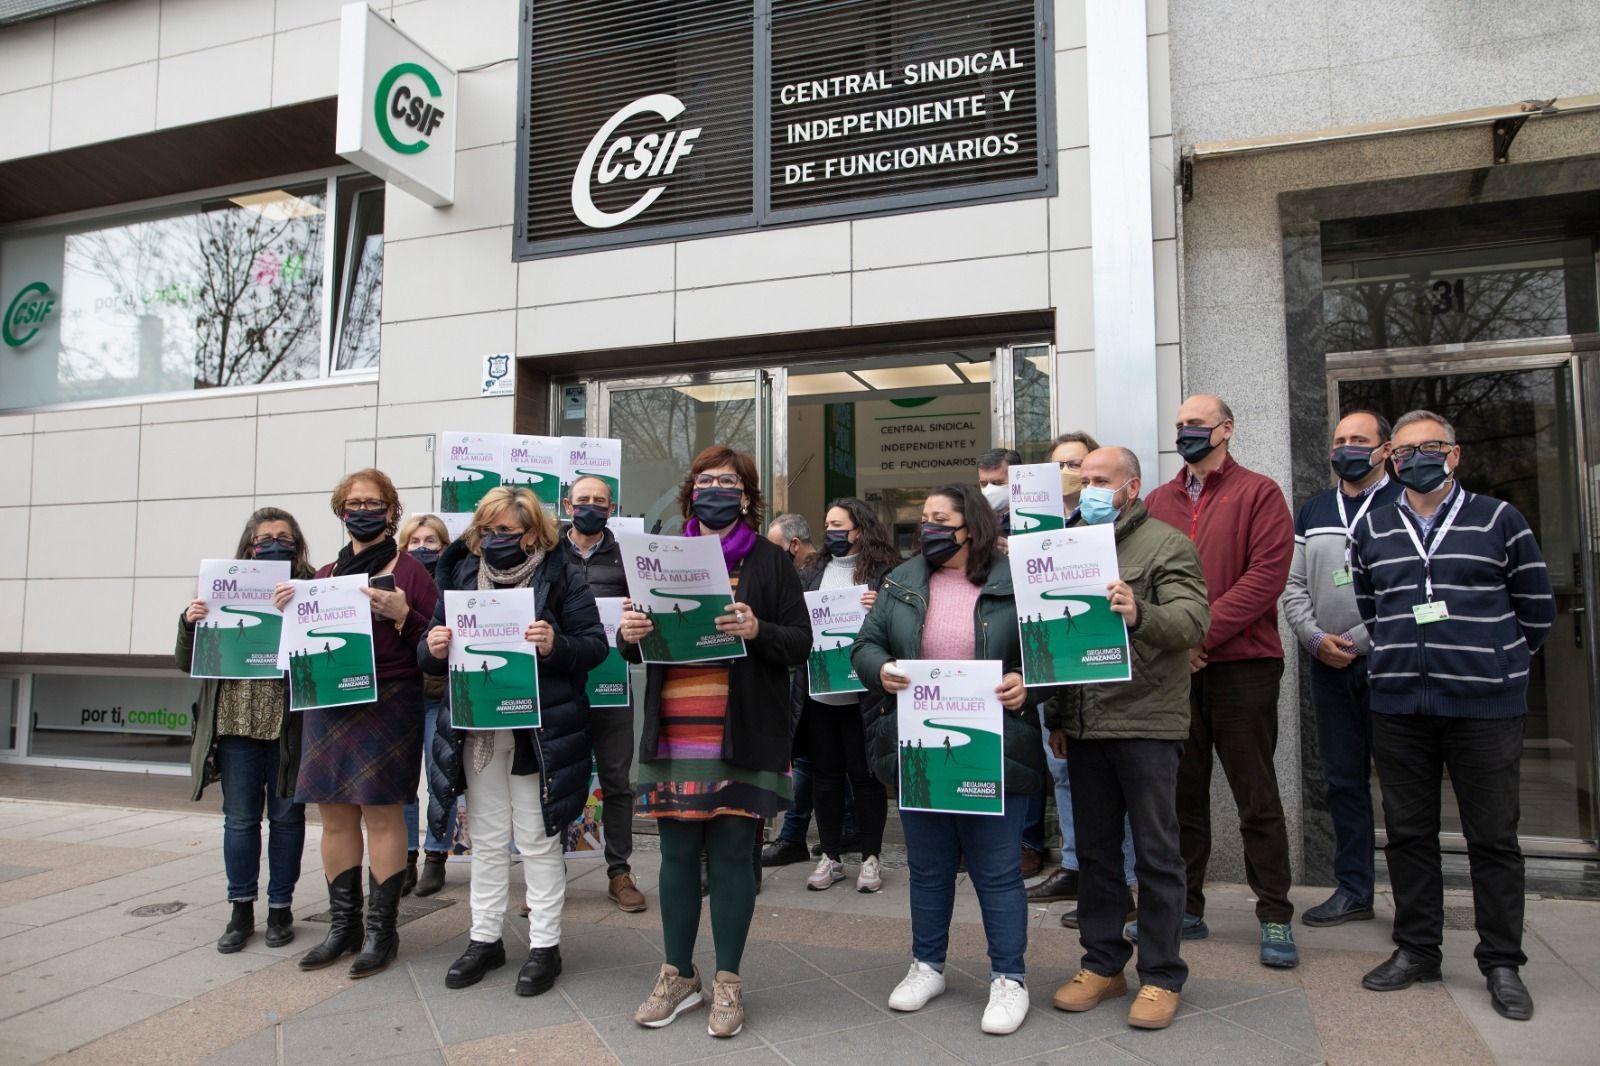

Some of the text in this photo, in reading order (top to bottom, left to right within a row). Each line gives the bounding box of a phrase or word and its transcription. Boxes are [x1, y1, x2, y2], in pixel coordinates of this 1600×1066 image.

[780, 47, 1024, 106] CENTRAL SINDICAL
[786, 89, 1016, 144] INDEPENDIENTE Y
[784, 132, 1020, 185] DE FUNCIONARIOS
[1432, 279, 1465, 315] 31
[880, 421, 976, 435] CENTRAL SINDICAL
[451, 446, 468, 455] 8M
[881, 439, 976, 452] INDEPENDIENTE Y
[511, 448, 528, 458] 8M
[569, 450, 586, 460] 8M
[881, 457, 977, 470] DE FUNCIONARIOS
[636, 556, 662, 573] 8M
[1026, 557, 1054, 575] 8M
[638, 570, 652, 580] DE
[653, 572, 667, 581] LA
[669, 572, 711, 583] MUJER
[1028, 567, 1101, 584] DE LA MUJER
[212, 579, 237, 592] 8M
[212, 592, 226, 600] DE
[228, 592, 240, 600] LA
[297, 601, 319, 616] 8M
[812, 607, 830, 619] 8M
[298, 615, 310, 625] DE
[311, 614, 323, 622] LA
[324, 609, 356, 622] MUJER
[457, 614, 477, 629] 8M
[834, 615, 861, 624] MUJER
[482, 627, 520, 637] MUJER
[1081, 654, 1122, 663] AVANZANDO
[1086, 648, 1121, 656] SEGUIMOS
[913, 685, 940, 701] 8M
[496, 704, 533, 712] AVANZANDO
[913, 701, 986, 712] DE LA MUJER
[81, 706, 188, 730] por ti, contigo
[957, 787, 996, 795] AVANZANDO
[962, 781, 996, 789] SEGUIMOS
